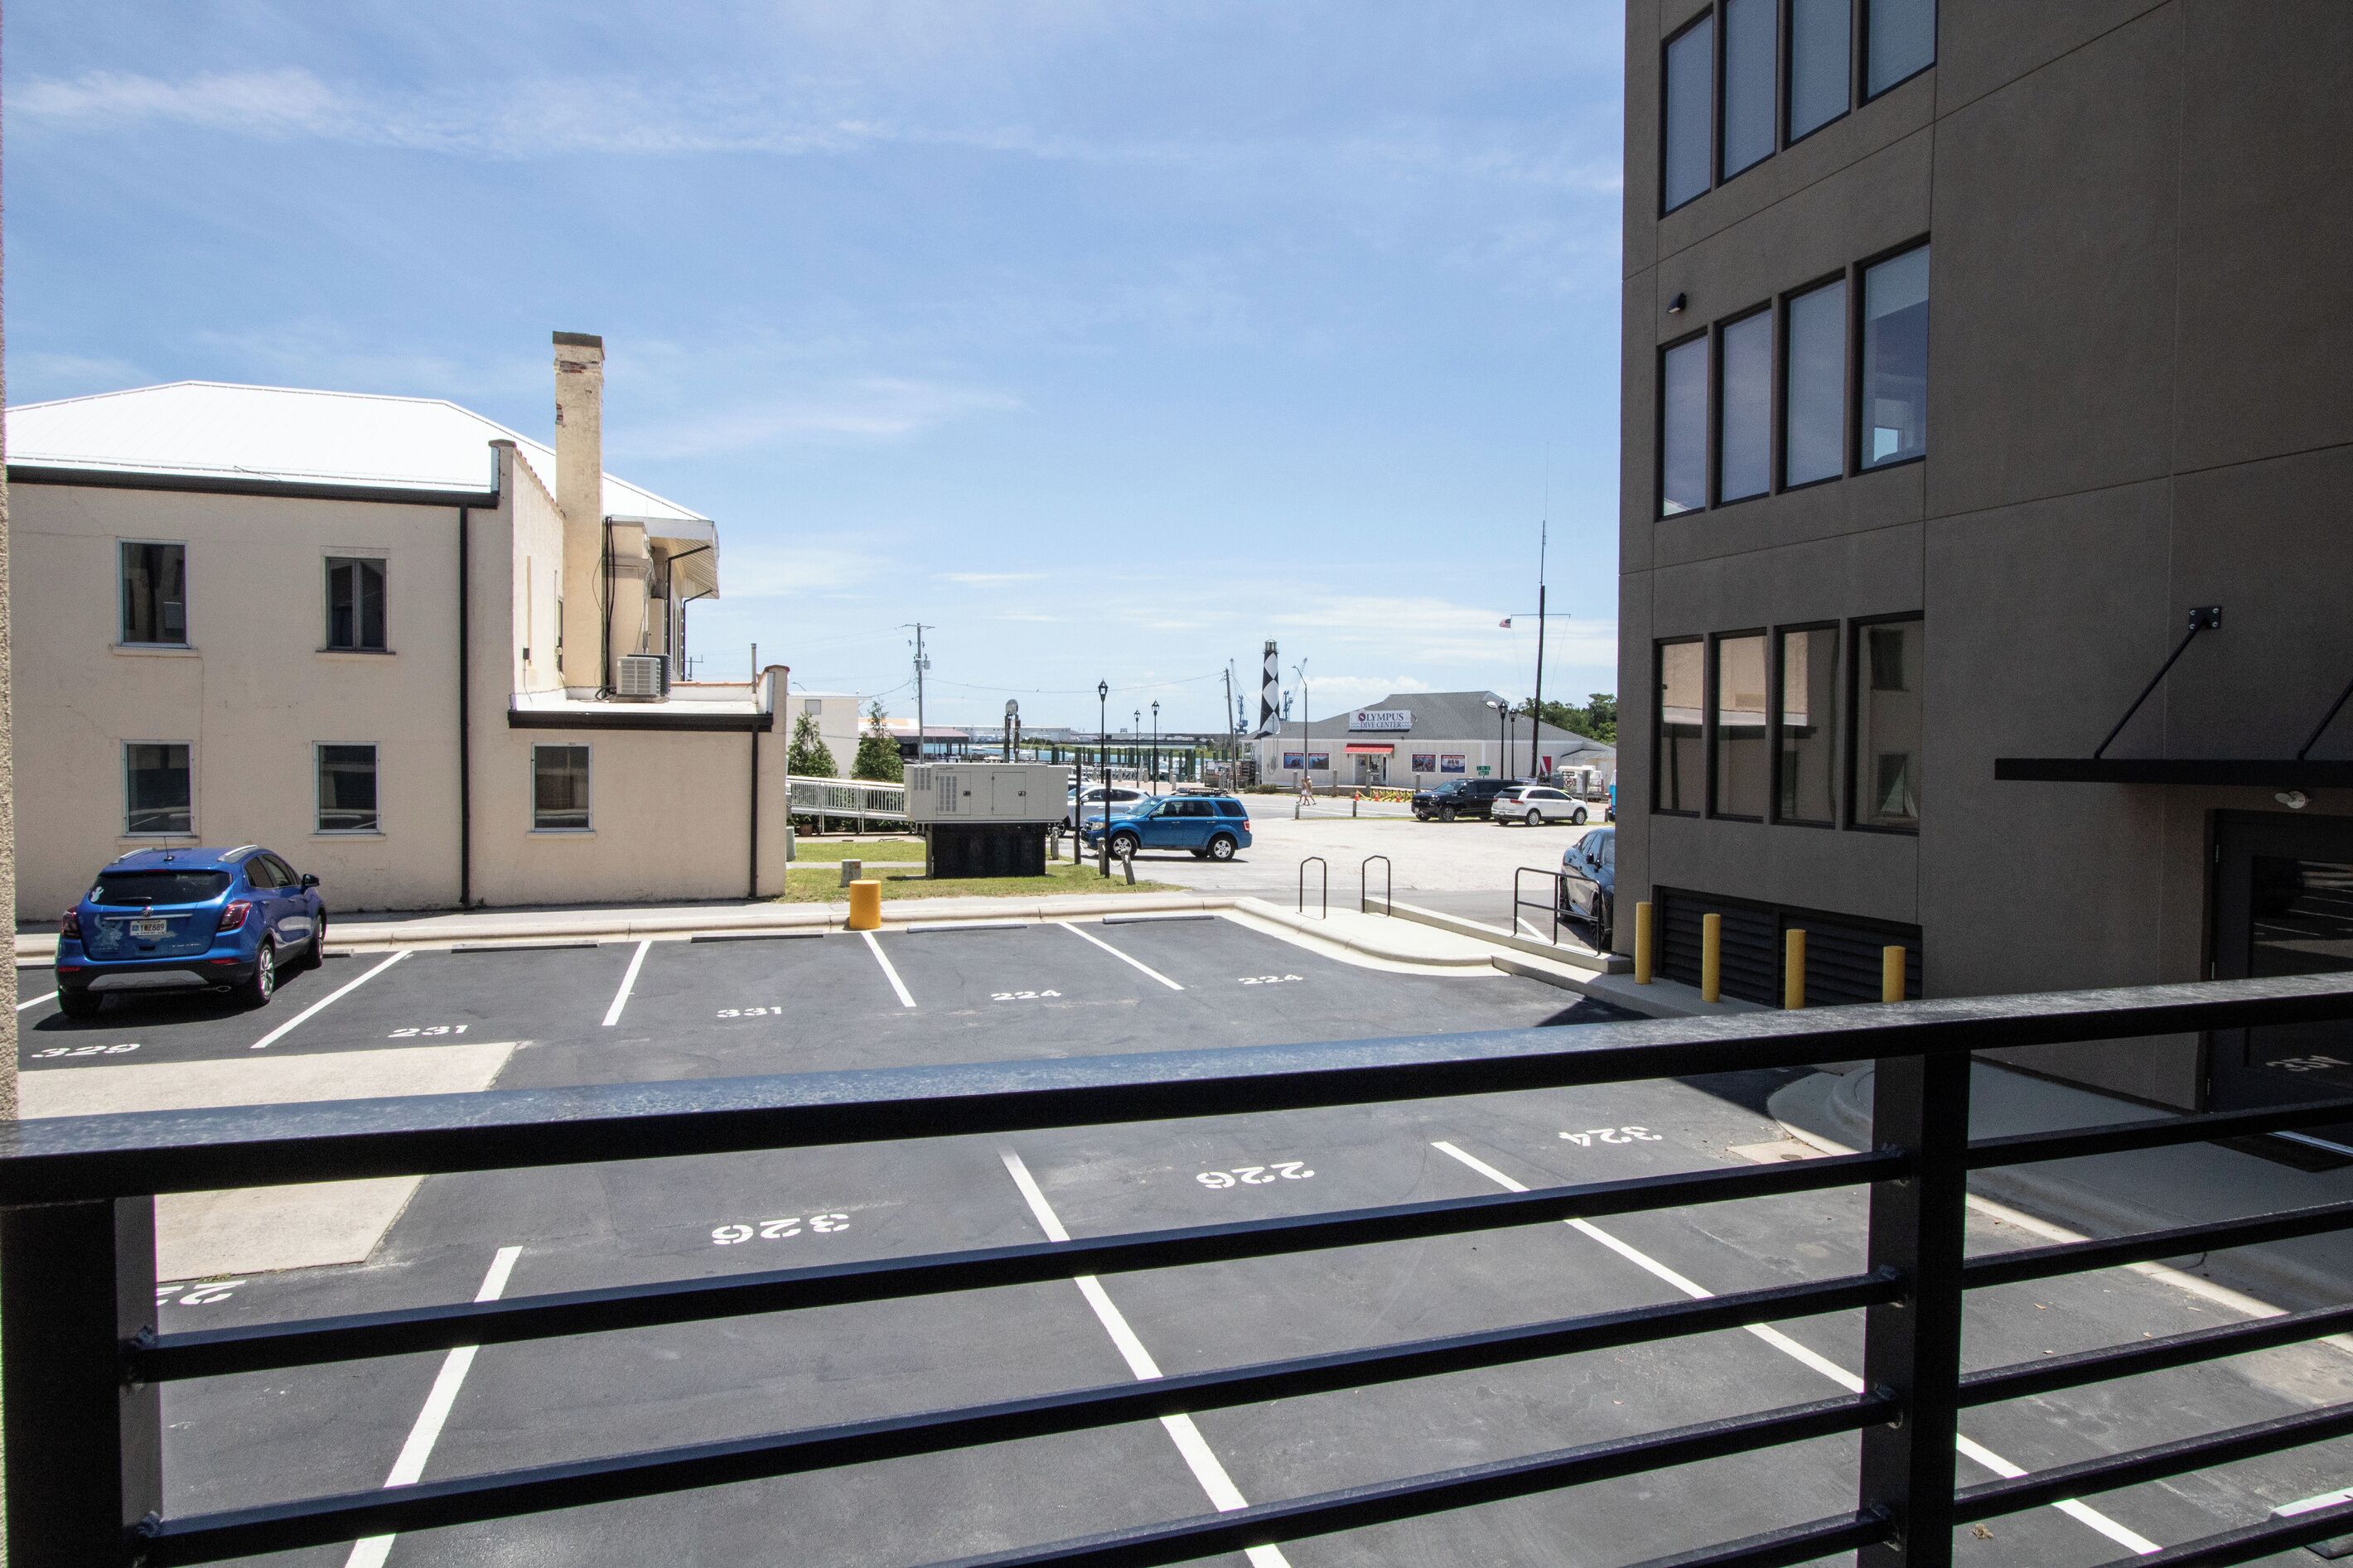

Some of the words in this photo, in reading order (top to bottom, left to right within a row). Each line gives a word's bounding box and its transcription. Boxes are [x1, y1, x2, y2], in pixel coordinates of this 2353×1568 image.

[1358, 712, 1404, 722] OLYMPUS
[1238, 973, 1304, 985] 224
[990, 989, 1062, 1001] 224
[717, 1006, 782, 1018] 331
[388, 1025, 468, 1038] 231
[31, 1043, 141, 1058] 329
[1558, 1126, 1664, 1147] 324
[1196, 1161, 1316, 1189] 226
[711, 1213, 850, 1245] 326
